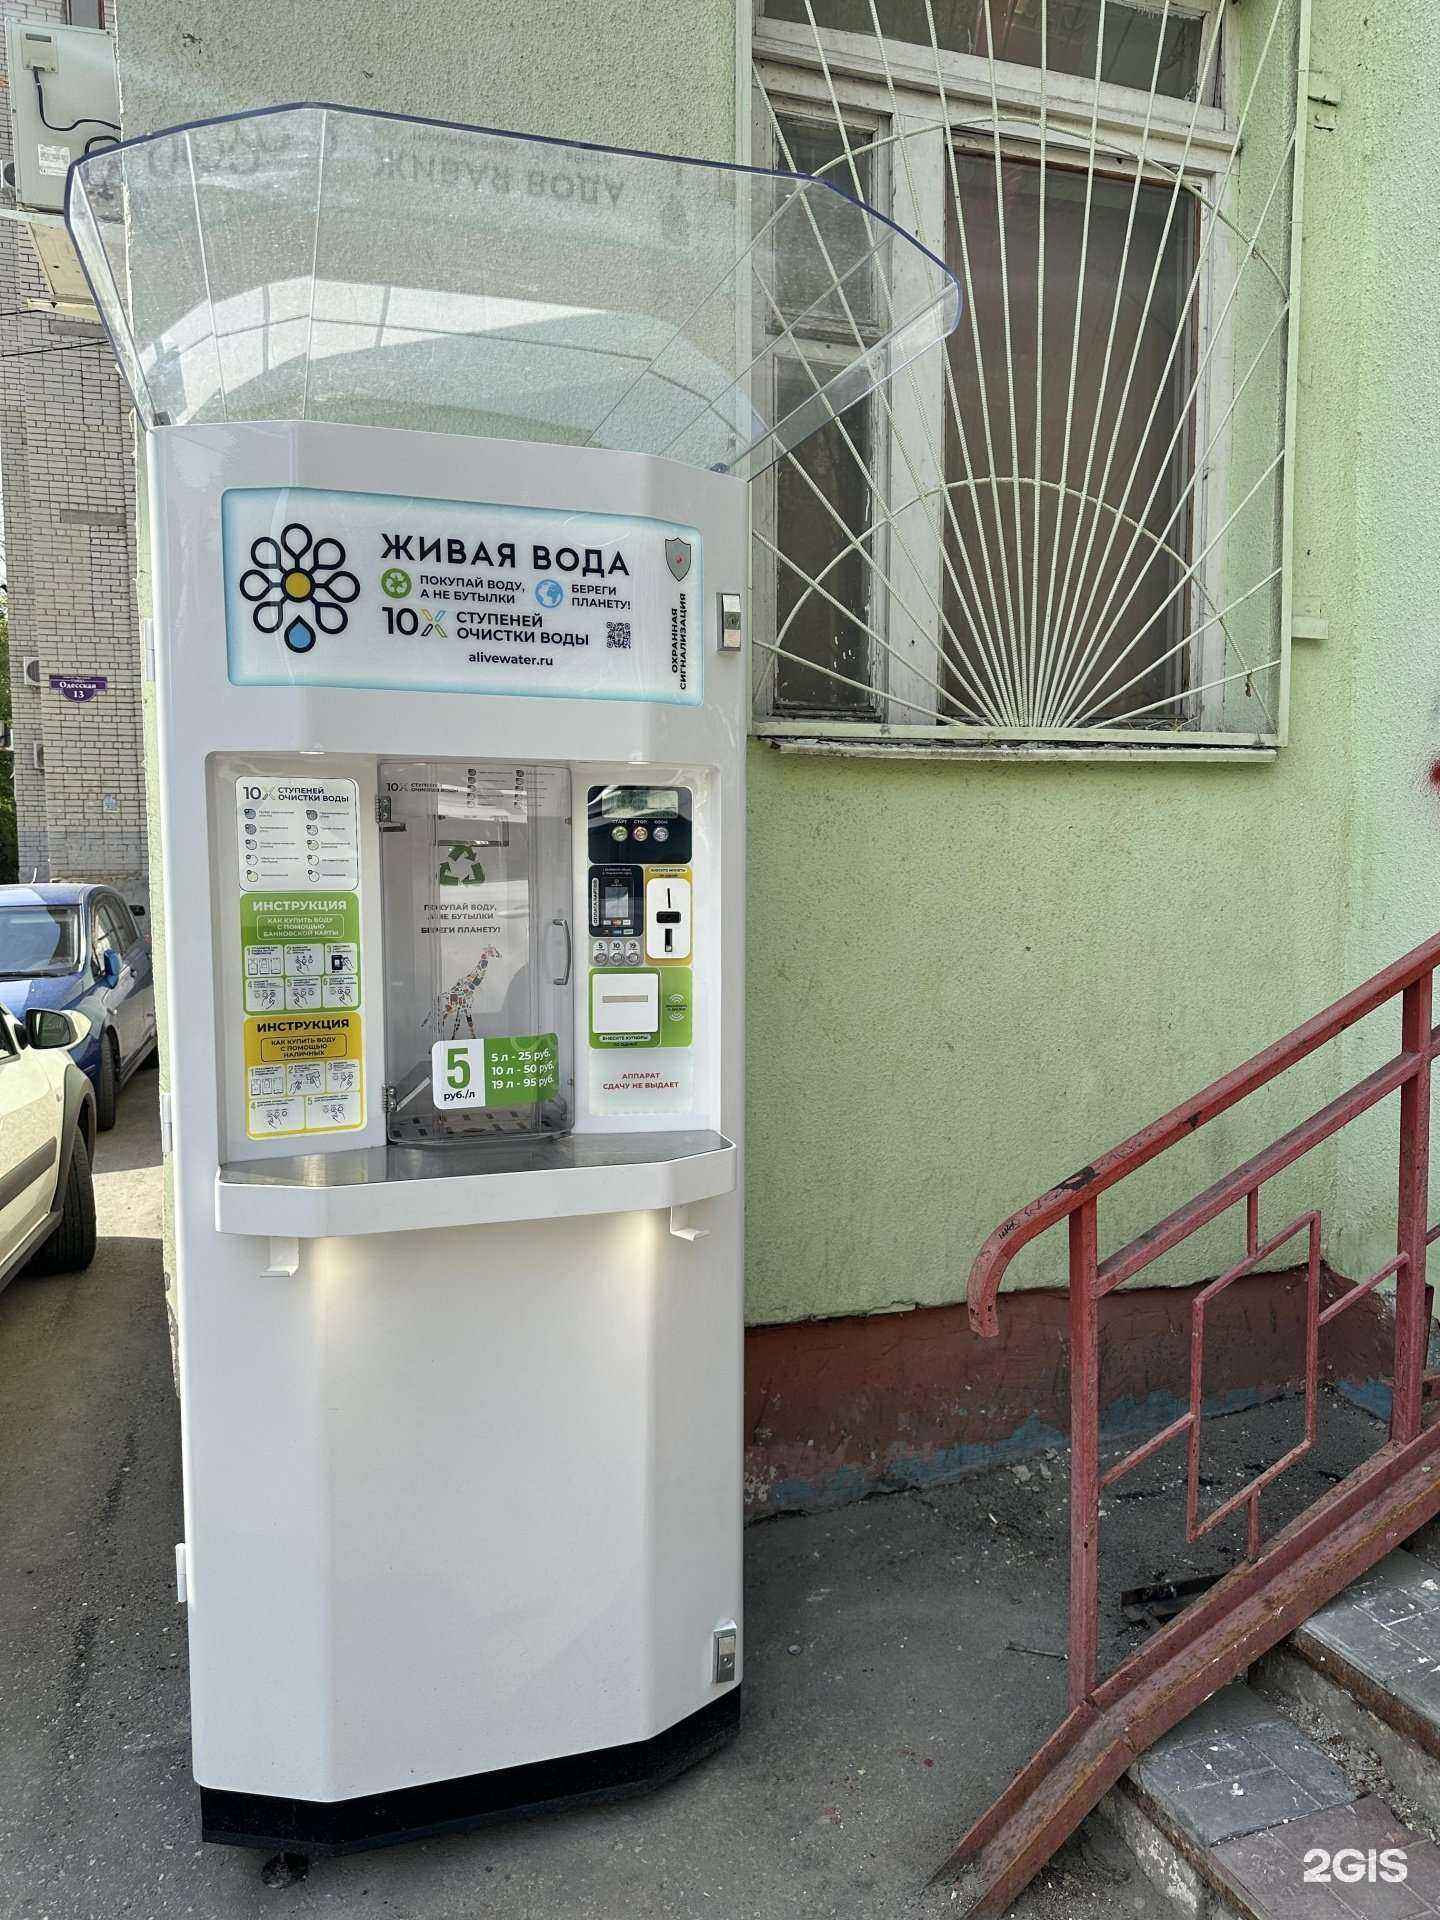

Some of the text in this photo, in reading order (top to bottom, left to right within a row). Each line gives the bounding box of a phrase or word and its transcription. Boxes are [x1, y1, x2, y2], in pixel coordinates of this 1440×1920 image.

[380, 533, 630, 578] ЖИВАЯ ВОДА
[420, 575, 525, 593] ПОКУПАЙ ВОДУ,
[571, 584, 617, 596] БЕРЕГИ
[420, 589, 515, 604] А НЕ БУТЫЛКИ
[571, 597, 631, 610] ПЛАНЕТУ!
[456, 611, 544, 628] СТУПЕНЕЙ
[456, 627, 589, 647] ОЧИСТКИ ВОДЫ
[671, 607, 679, 674] ОХРАННАЯ
[679, 592, 688, 690] СИГНАЛИЗАЦИЯ
[468, 651, 554, 666] alivewater.ru
[73, 690, 86, 699] 13
[278, 786, 326, 795] СТУПЕНЕЙ
[278, 794, 350, 803] ОЧИСТКИ ВОДЫ
[252, 900, 348, 912] ИНСТРУКЦИЯ
[256, 1018, 350, 1033] ИНСТРУКЦИЯ
[271, 1038, 286, 1046] КАК
[287, 1037, 316, 1045] КУПИТЬ
[287, 1043, 328, 1051] ПОМОЩЬЮ
[283, 1051, 325, 1059] НАЛИЧНЫХ
[491, 1053, 498, 1062] 5
[500, 1054, 509, 1062] л
[518, 1051, 532, 1060] 25
[534, 1048, 551, 1061] руб.
[447, 1047, 472, 1090] 5
[491, 1066, 504, 1076] 10
[505, 1068, 514, 1076] л
[523, 1064, 537, 1074] 50
[539, 1061, 555, 1073] руб.
[622, 1072, 660, 1080] АППАРАТ
[491, 1080, 504, 1090] 19
[523, 1078, 537, 1088] 95
[603, 1083, 630, 1091] СДАЧУ
[645, 1081, 679, 1089] ВЫДАЕТ
[443, 1089, 476, 1102] руб./л
